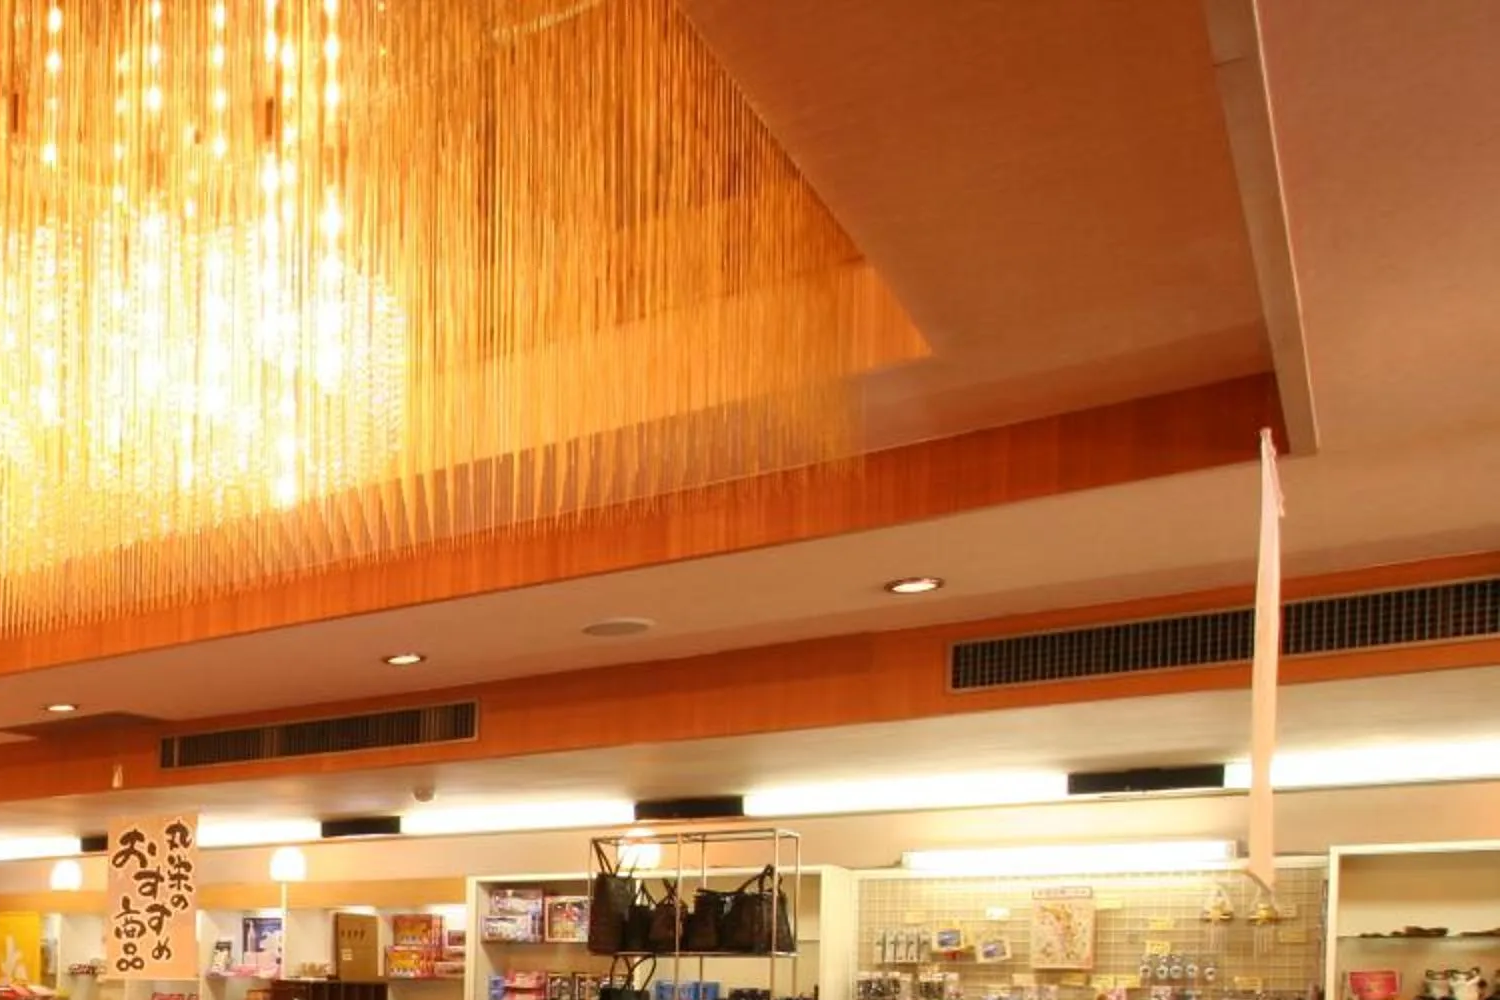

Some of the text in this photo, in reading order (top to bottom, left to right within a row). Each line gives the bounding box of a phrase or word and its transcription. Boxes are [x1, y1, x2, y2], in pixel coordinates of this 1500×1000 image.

[112, 829, 172, 960] おすすめ
[114, 896, 147, 972] 商品
